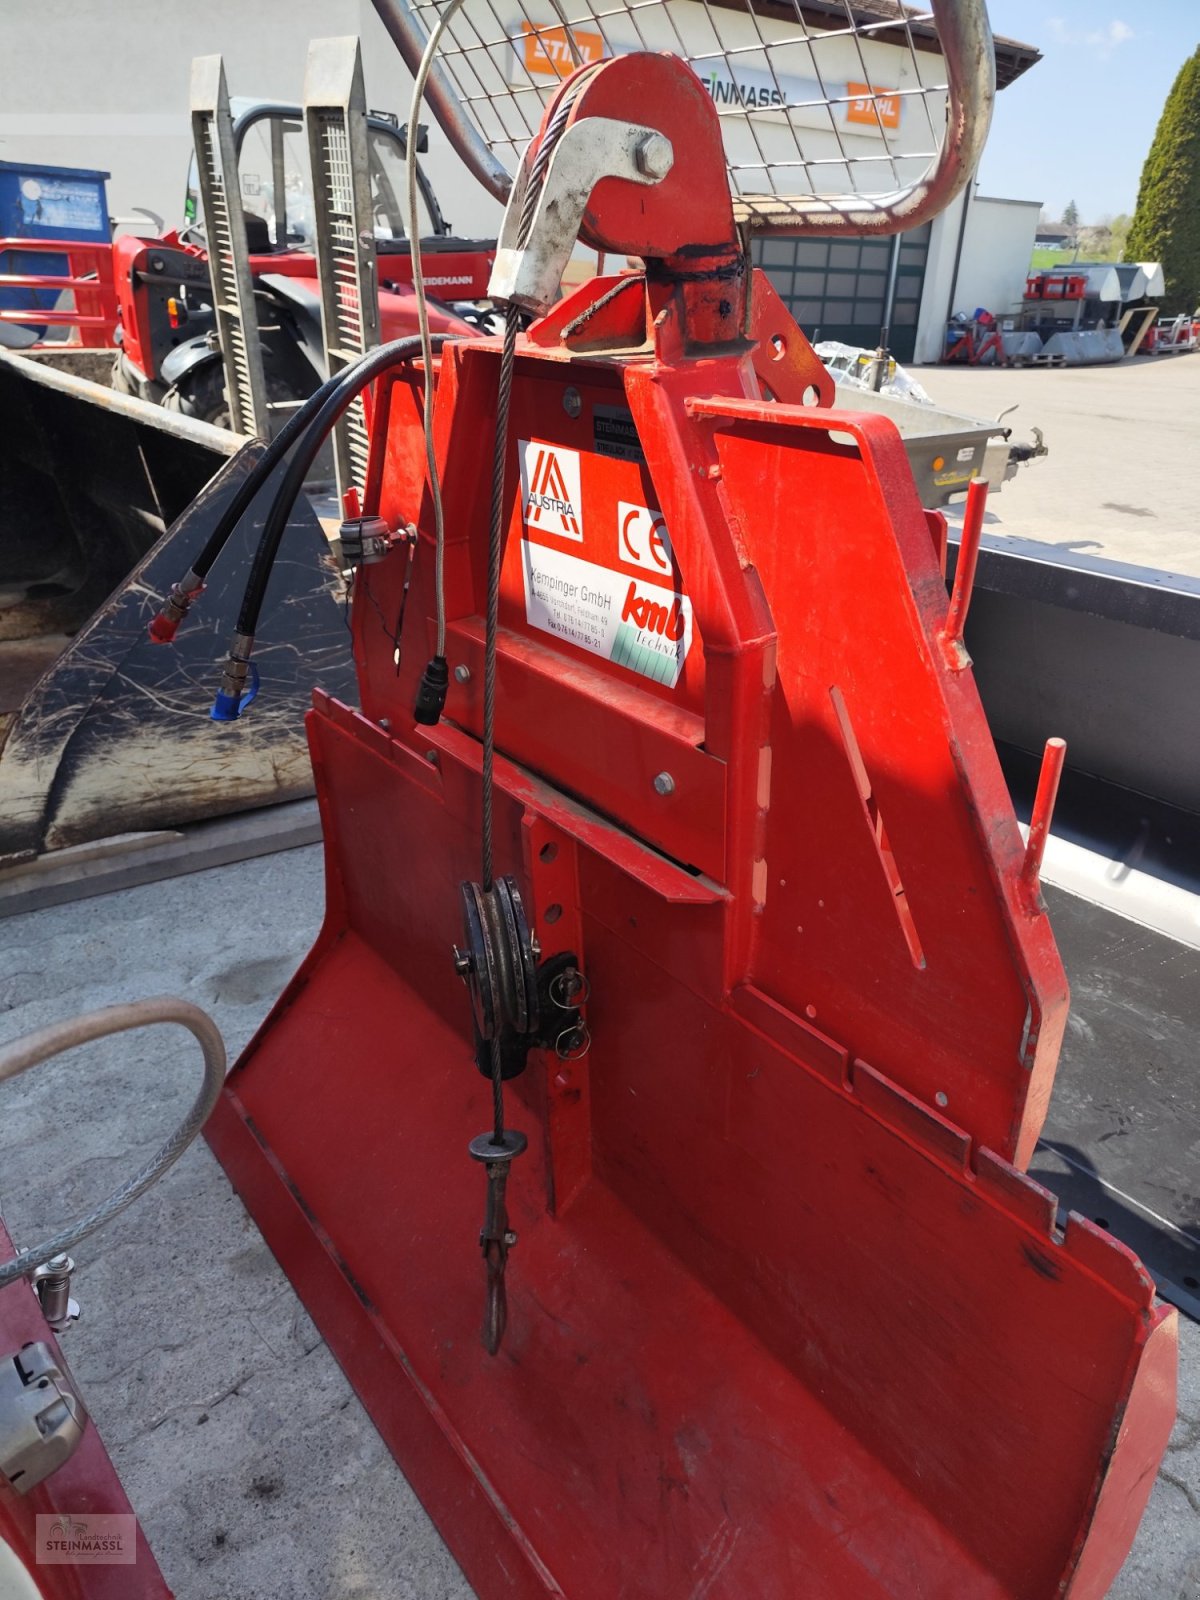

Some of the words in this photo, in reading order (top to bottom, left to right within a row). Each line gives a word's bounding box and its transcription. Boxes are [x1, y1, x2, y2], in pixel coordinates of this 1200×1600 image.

[854, 98, 896, 116] STIHL
[411, 275, 473, 287] EIDEMANN
[527, 491, 575, 517] AUSTRIA
[530, 567, 578, 598] Kempinger
[580, 585, 611, 611] GmbH
[621, 580, 685, 642] kmb
